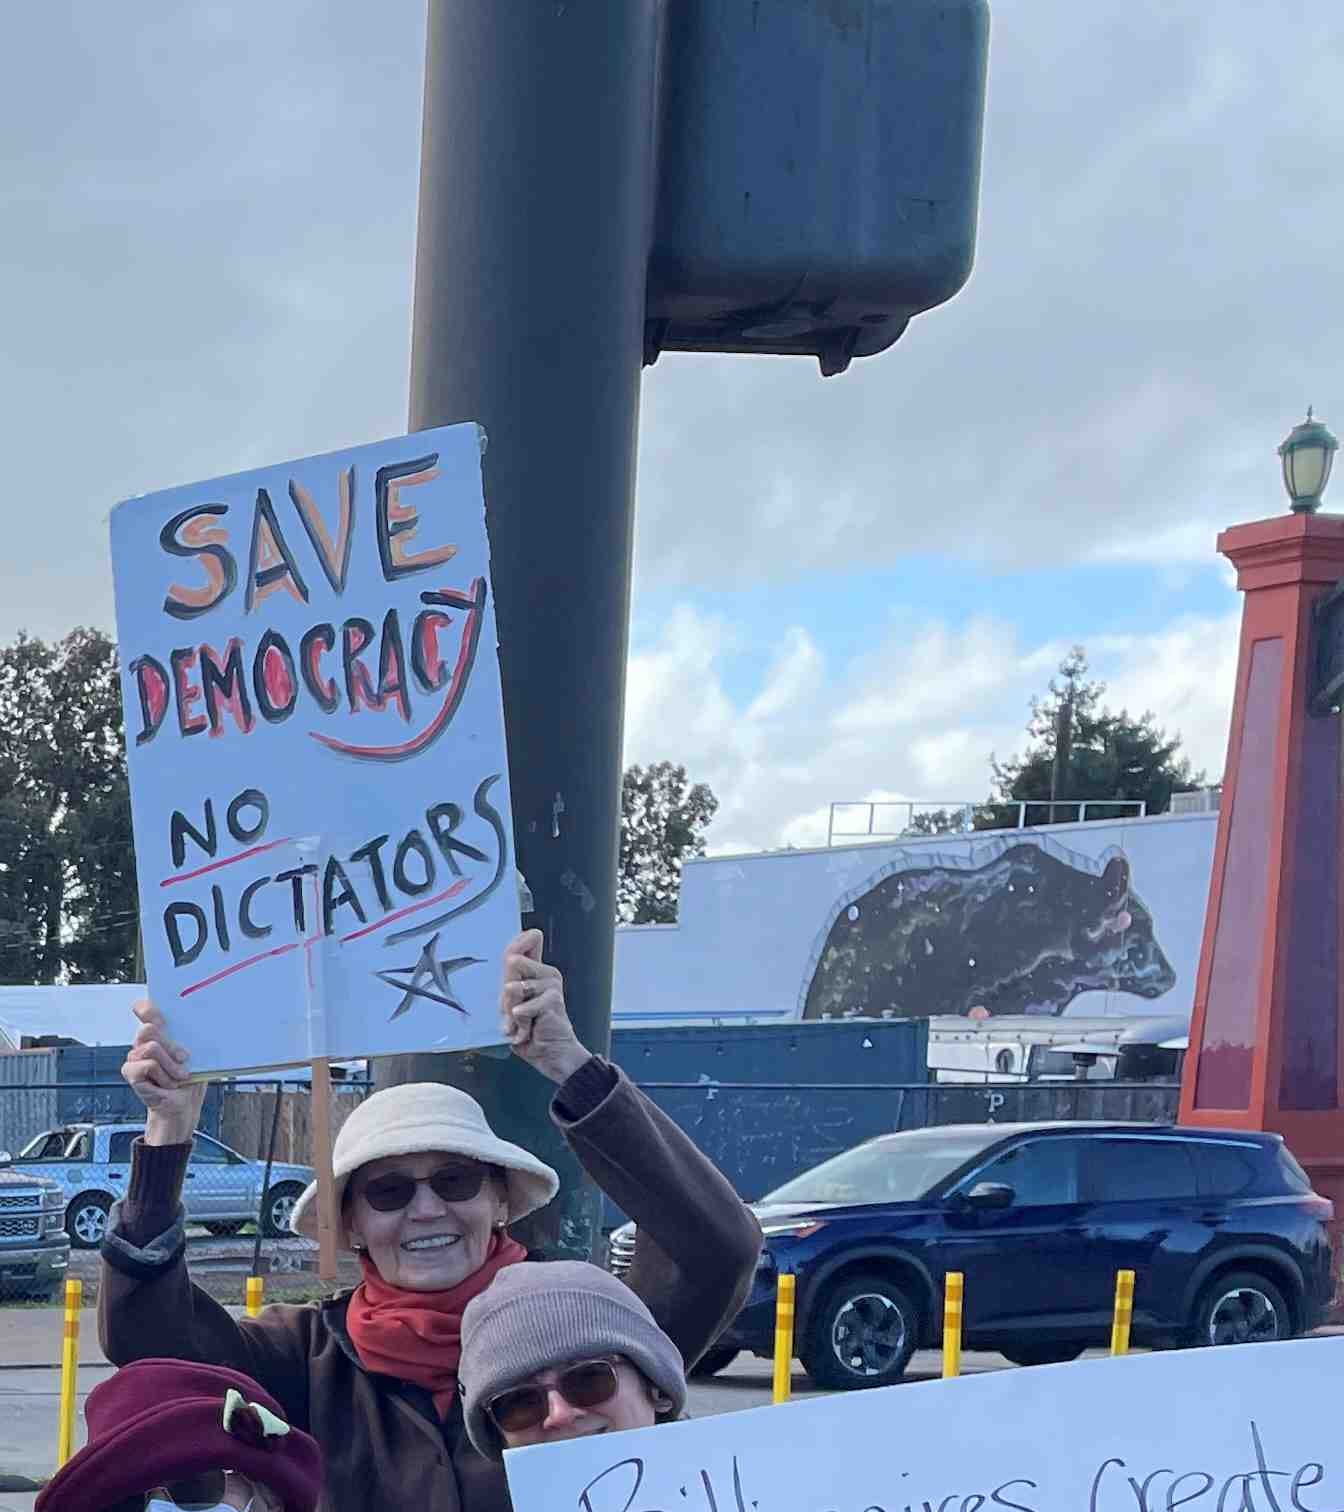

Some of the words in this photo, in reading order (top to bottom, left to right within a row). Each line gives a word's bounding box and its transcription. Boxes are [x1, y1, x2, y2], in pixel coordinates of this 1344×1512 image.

[159, 452, 456, 620] SAVE
[129, 576, 486, 763] DEMOCRACY
[161, 773, 509, 969] DICTATORS
[169, 788, 270, 868] NO
